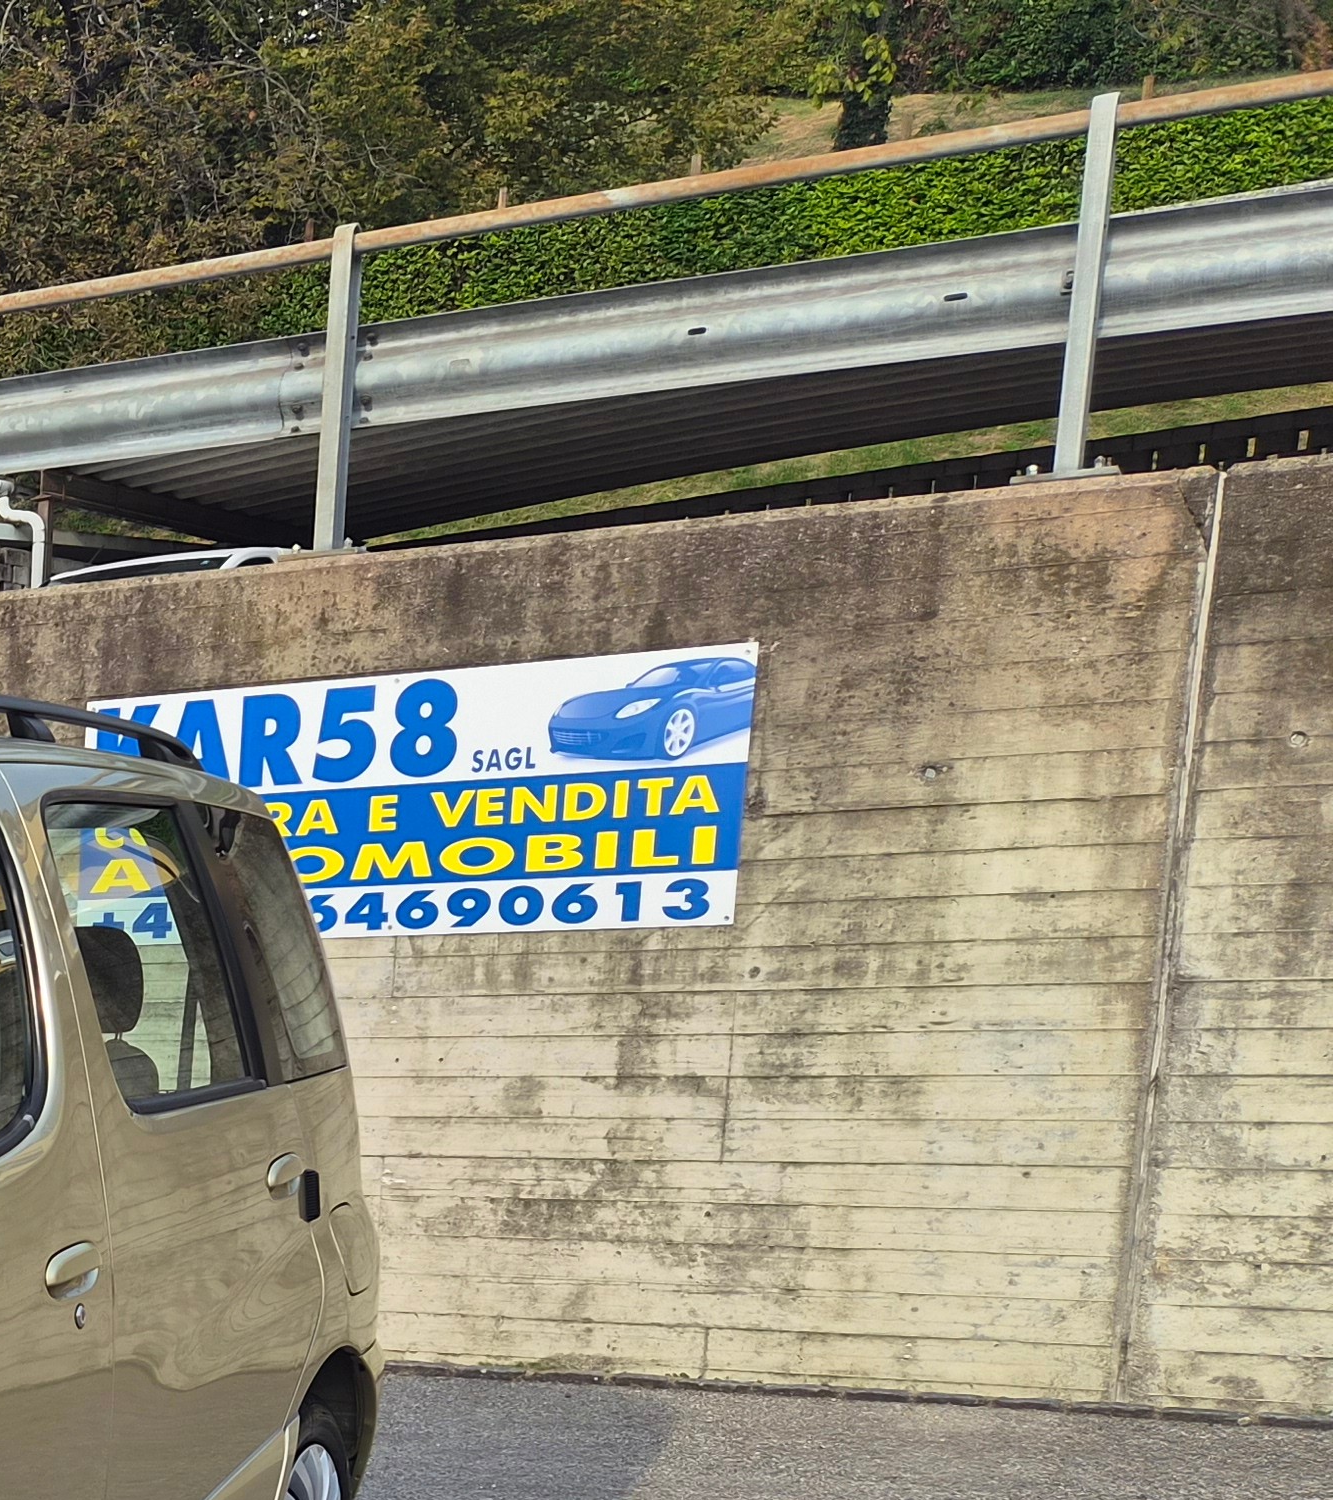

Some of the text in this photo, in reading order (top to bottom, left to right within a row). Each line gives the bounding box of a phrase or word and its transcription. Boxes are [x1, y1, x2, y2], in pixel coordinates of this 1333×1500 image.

[471, 746, 536, 774] SAGL
[367, 794, 398, 832] E
[431, 775, 720, 828] VENDITA
